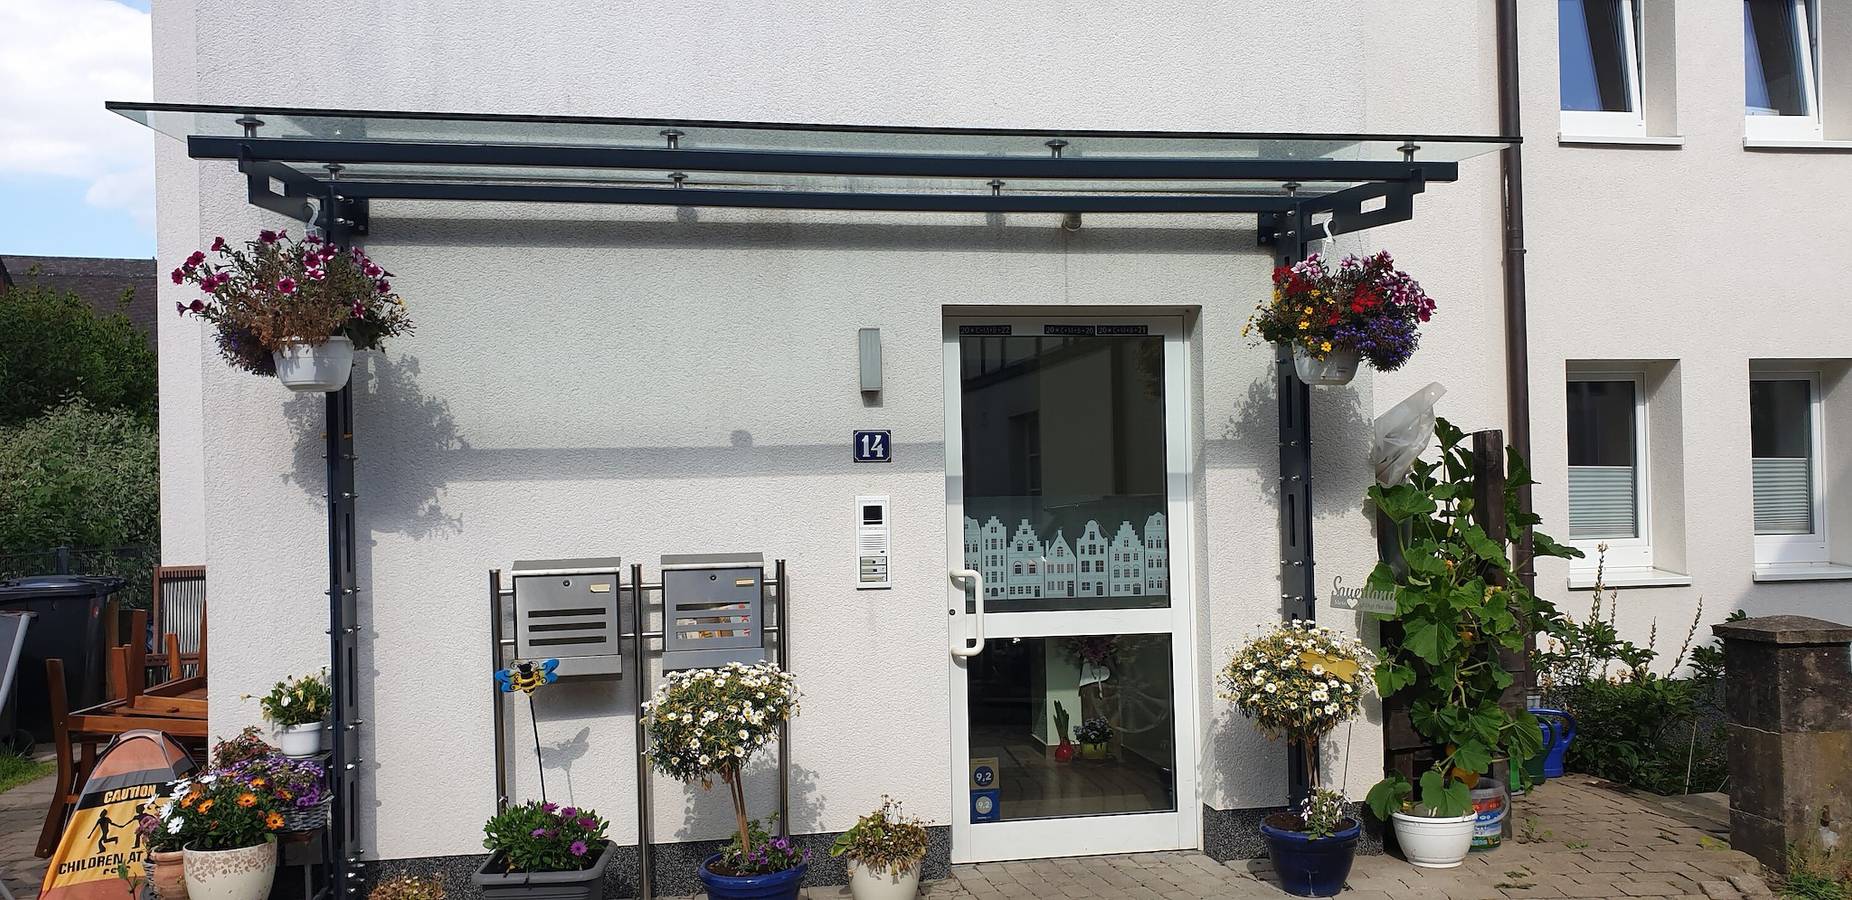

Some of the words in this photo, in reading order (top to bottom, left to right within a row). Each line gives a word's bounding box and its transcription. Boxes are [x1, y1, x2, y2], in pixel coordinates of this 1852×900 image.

[861, 434, 884, 458] 14
[1331, 575, 1397, 601] Sauerland
[976, 772, 992, 782] 9,2
[103, 784, 157, 804] CAUTION
[58, 853, 124, 875] CHILDREN
[127, 851, 143, 864] AT
